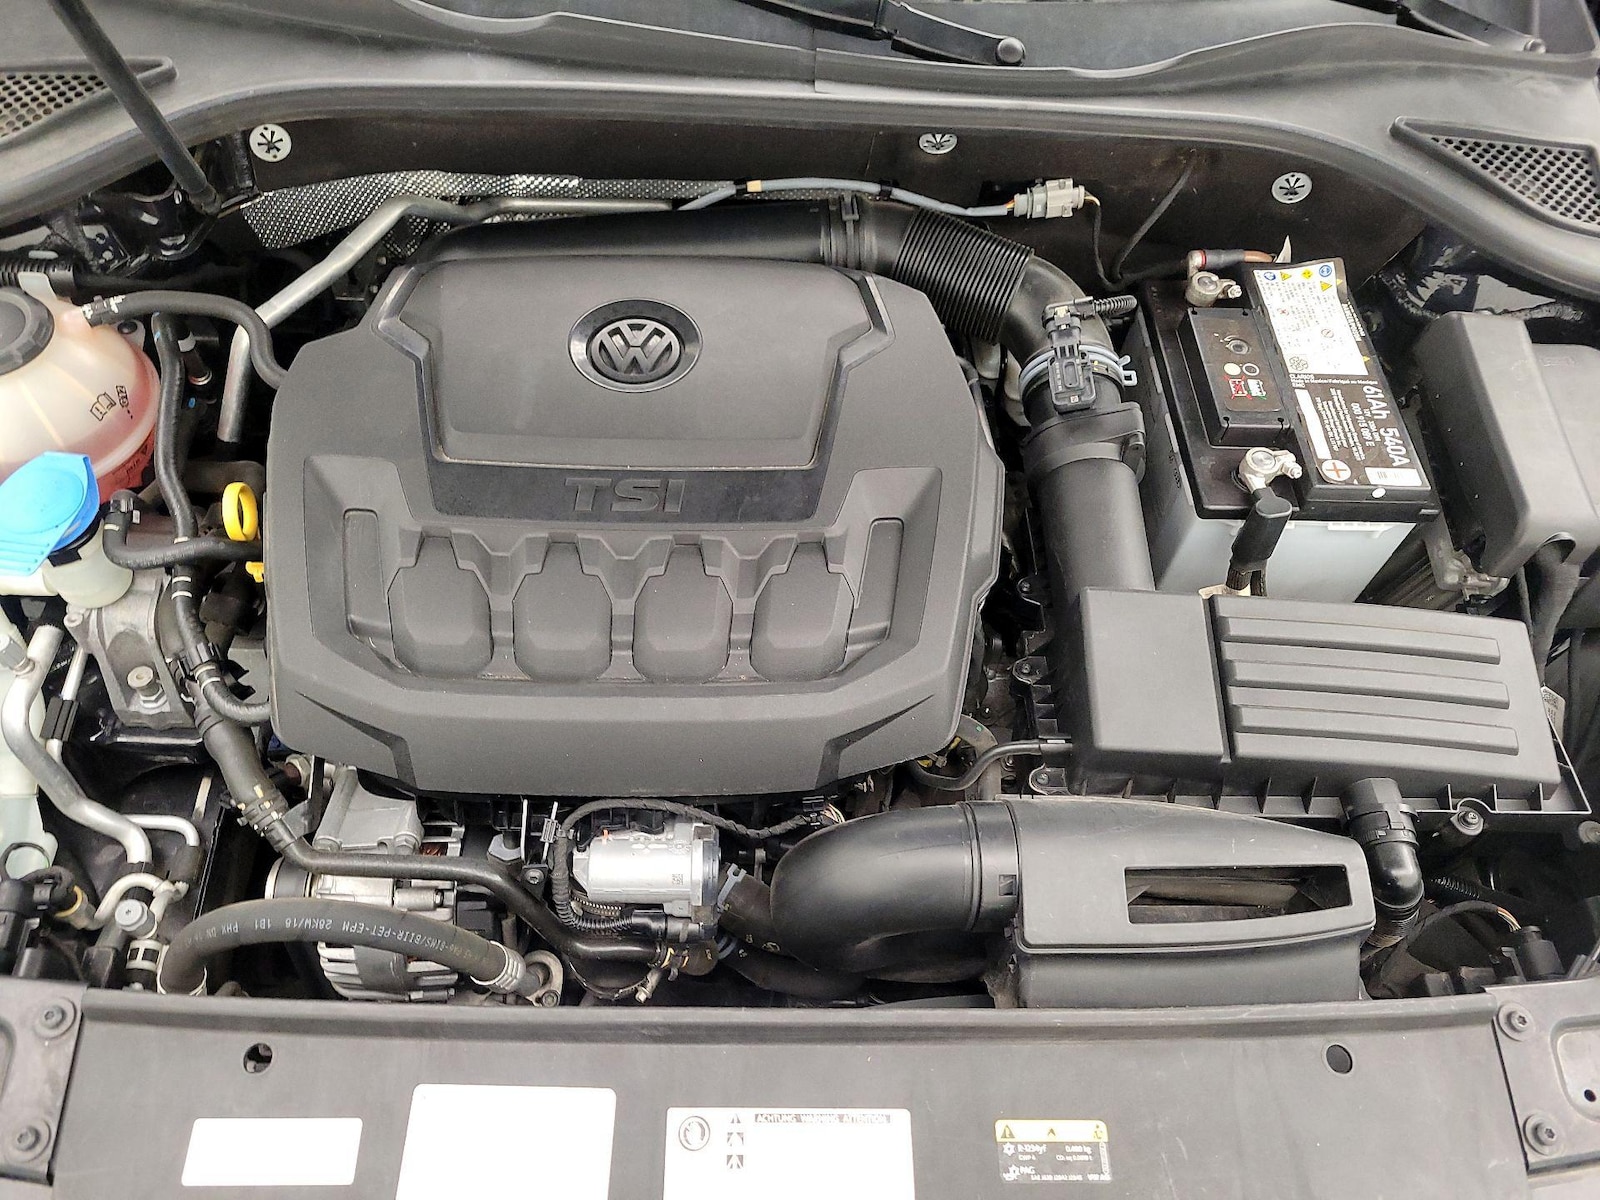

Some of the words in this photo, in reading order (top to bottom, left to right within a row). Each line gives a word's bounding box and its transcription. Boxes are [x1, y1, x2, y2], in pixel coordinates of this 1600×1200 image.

[590, 318, 681, 383] VW
[1363, 385, 1391, 419] 61Ah
[1380, 427, 1410, 466] 540A
[565, 478, 686, 512] TSI
